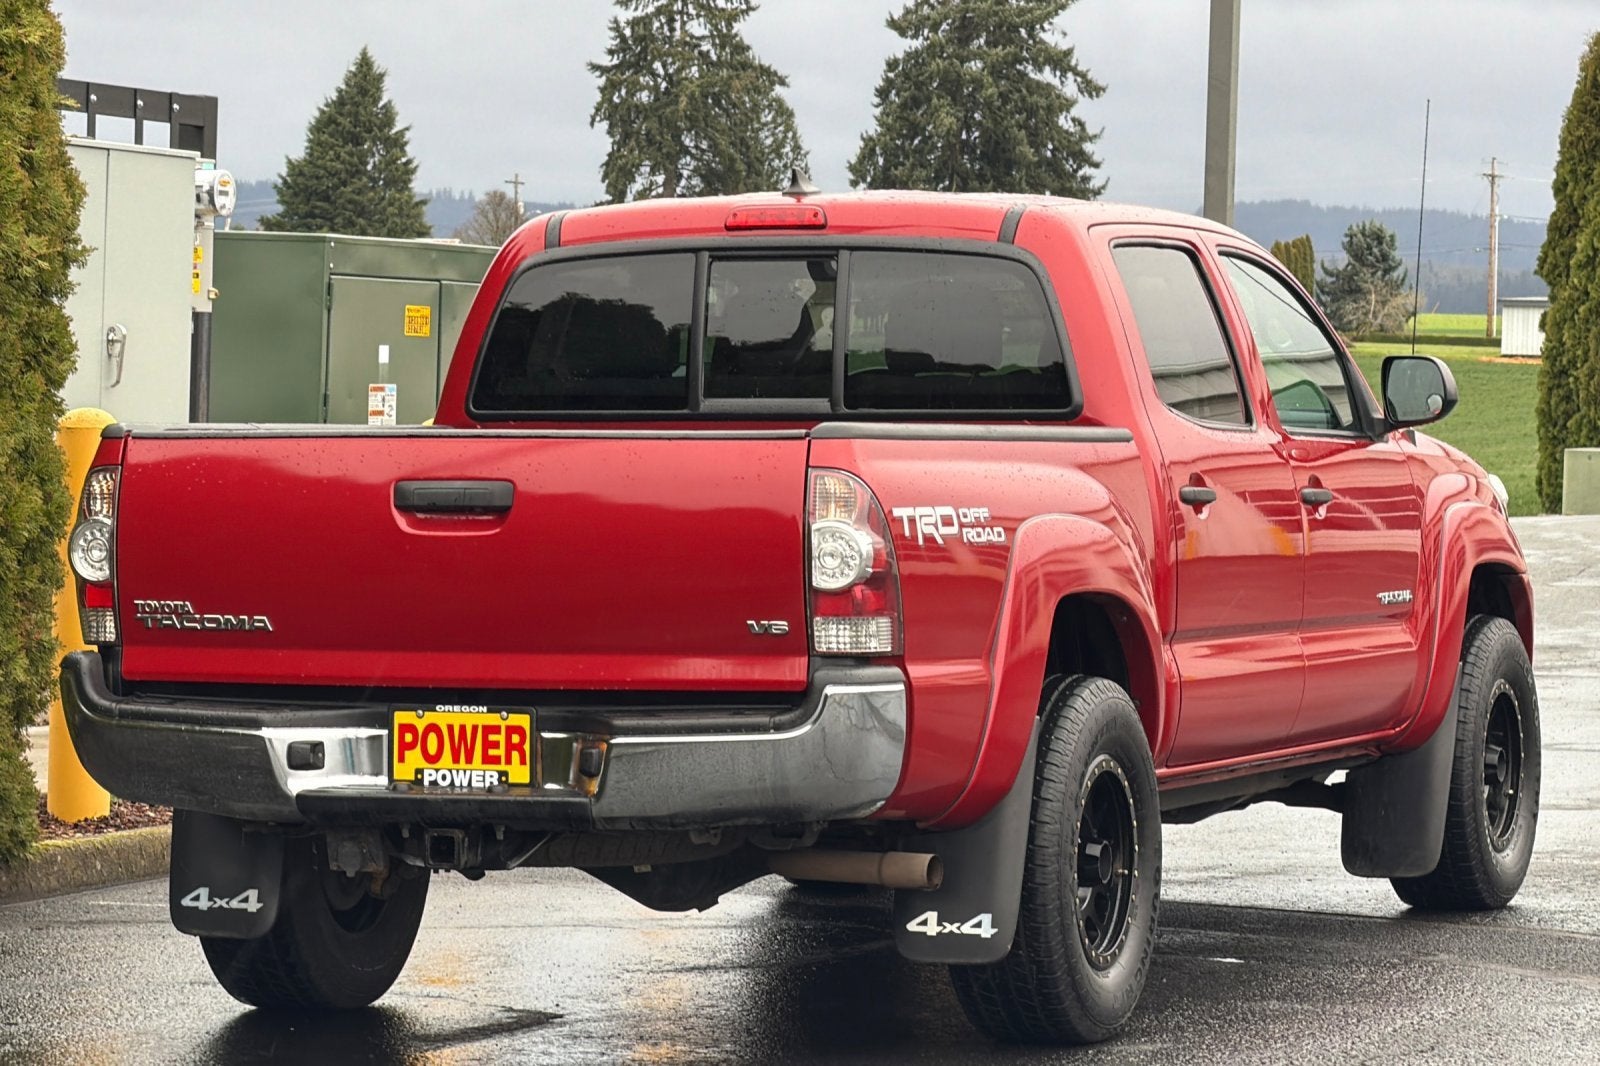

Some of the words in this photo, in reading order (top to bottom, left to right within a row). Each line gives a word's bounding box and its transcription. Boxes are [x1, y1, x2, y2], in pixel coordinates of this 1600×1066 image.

[891, 505, 959, 546] TRD
[958, 507, 990, 524] OFF
[962, 526, 1006, 544] ROAD
[134, 600, 194, 614] TOYOTA
[135, 613, 273, 632] TACOMA
[746, 620, 789, 634] V6
[435, 704, 488, 713] OREGON
[397, 722, 527, 766] POWER
[423, 768, 499, 789] POWER
[180, 887, 264, 913] 4x4
[905, 911, 999, 939] 4x4
